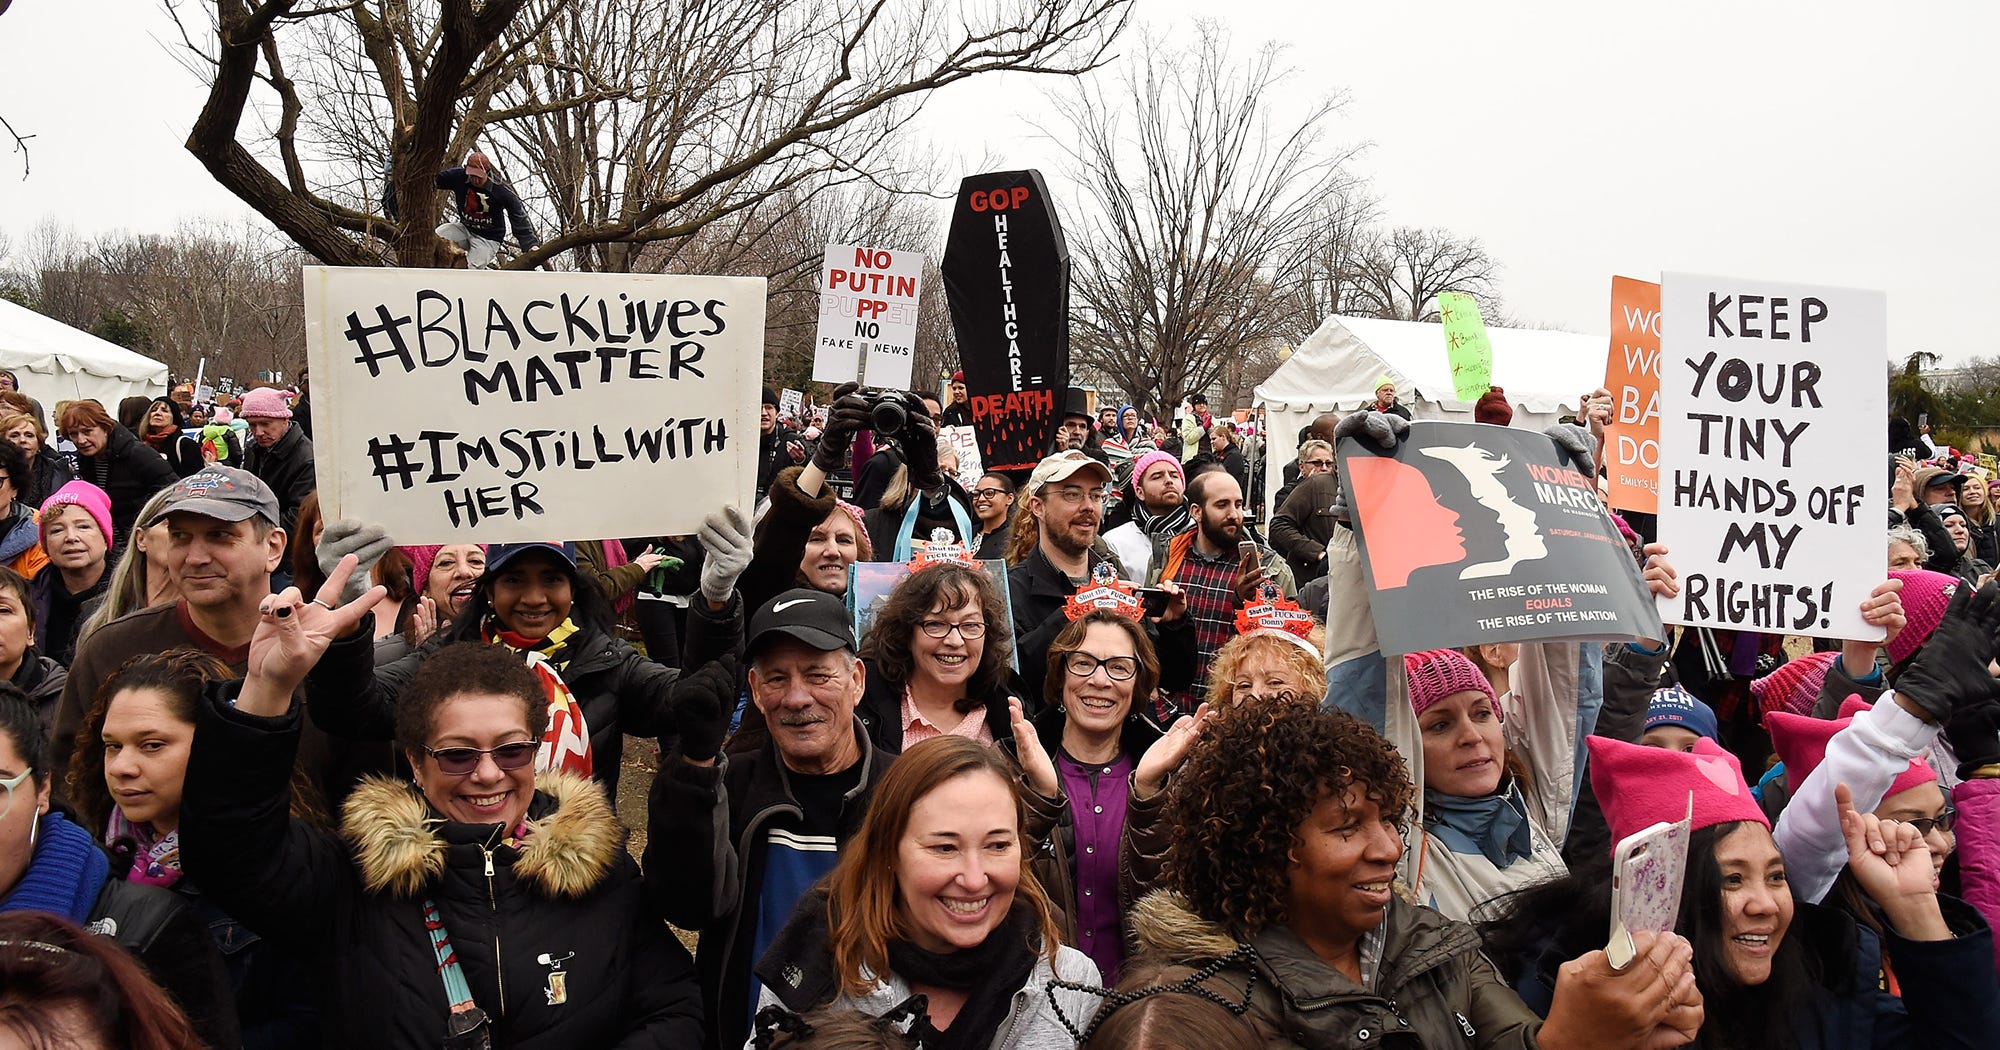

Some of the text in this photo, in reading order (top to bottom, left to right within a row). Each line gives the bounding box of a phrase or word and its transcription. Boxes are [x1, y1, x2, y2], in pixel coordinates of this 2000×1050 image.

[970, 187, 1029, 212] GOP
[854, 248, 892, 270] NO
[829, 269, 915, 297] PUTIN
[820, 294, 918, 325] PUPPET
[994, 214, 1022, 392] HEALTHCARE
[854, 321, 880, 339] NO
[1707, 291, 1829, 343] KEEP
[822, 337, 909, 356] FAKE NEWS
[463, 340, 705, 405] MATTER
[1685, 351, 1823, 409] YOUR
[970, 389, 1054, 419] DEATH
[1687, 412, 1811, 468] TINY
[444, 481, 545, 528] HER
[1674, 469, 1865, 526] HANDS OFF
[926, 552, 948, 560] FUCK
[1717, 522, 1803, 570] MY
[1078, 588, 1107, 601] Shut the
[1110, 590, 1128, 601] FUCK
[1468, 583, 1608, 601] THE RISE OF THE WOMAN
[1525, 597, 1573, 610] EQUALS
[1683, 573, 1834, 630] RIGHTS!
[1261, 619, 1284, 627] Donny
[1274, 611, 1295, 619] FUCK
[1477, 611, 1618, 630] THE RISE OF THE NATION
